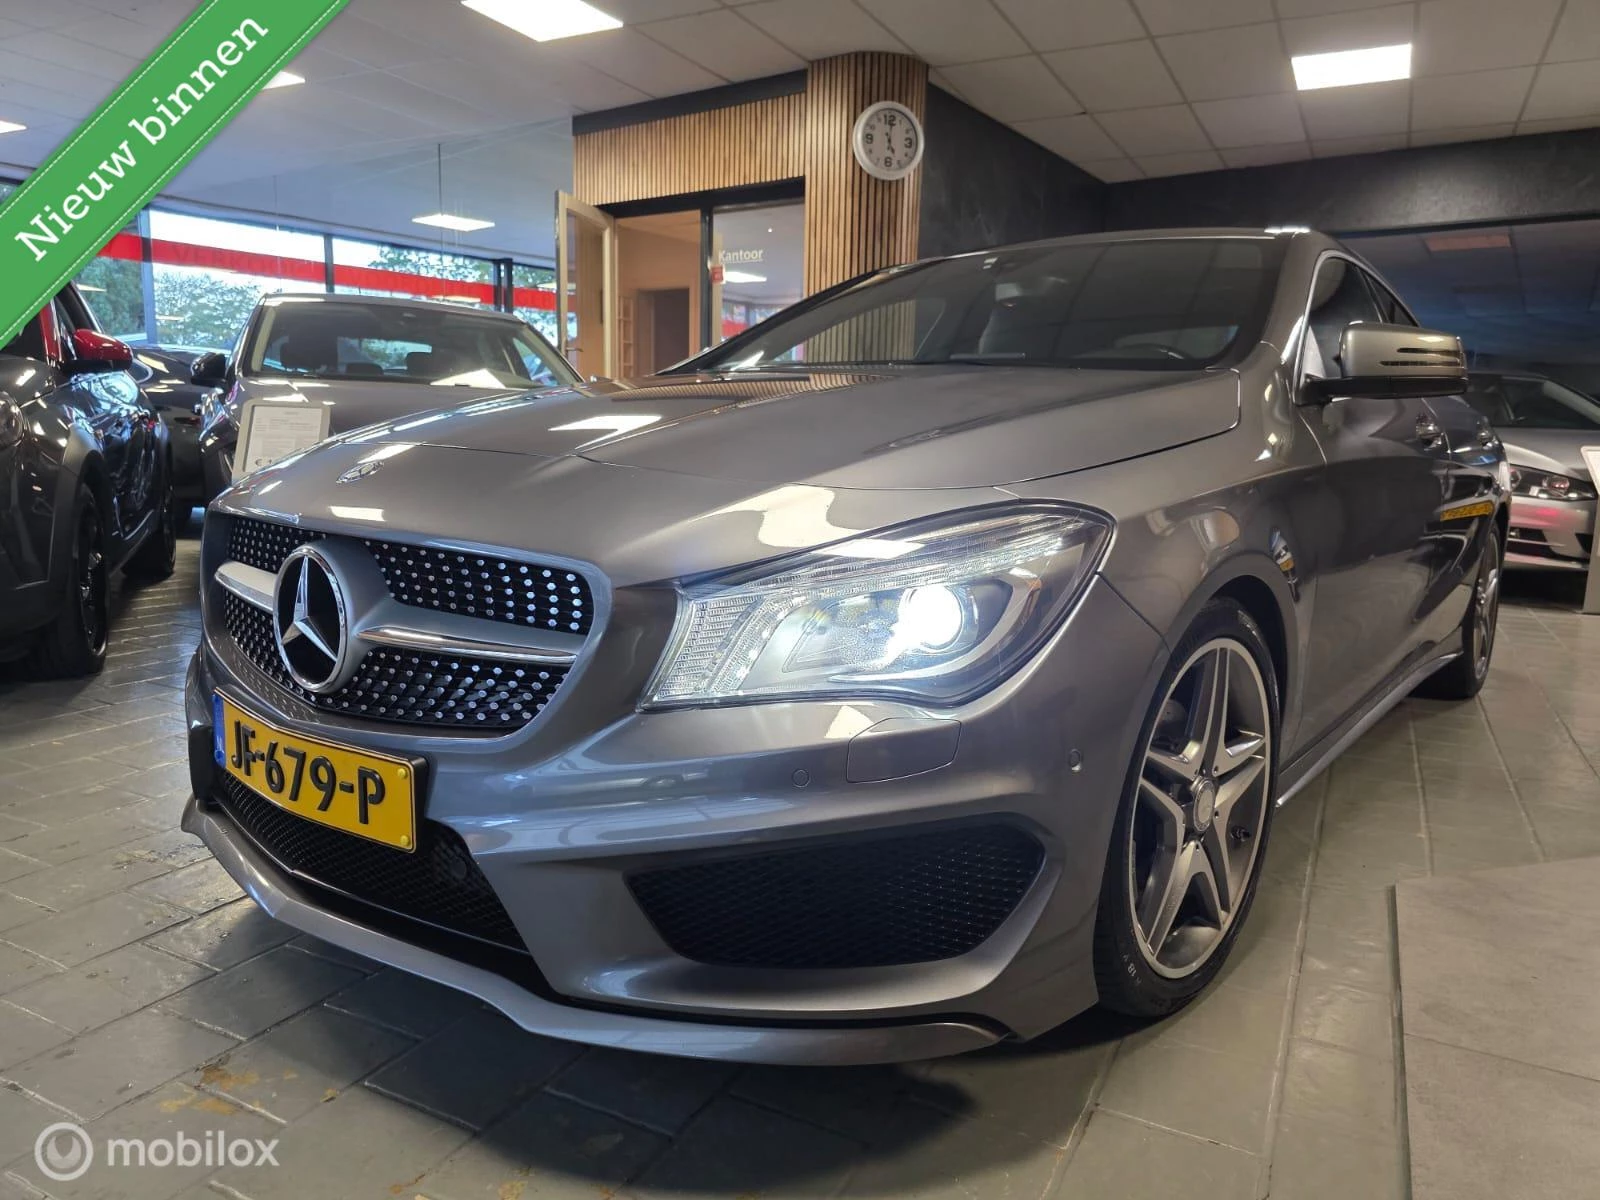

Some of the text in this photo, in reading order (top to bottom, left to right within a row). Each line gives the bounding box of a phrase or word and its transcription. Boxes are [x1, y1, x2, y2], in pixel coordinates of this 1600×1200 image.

[884, 113, 896, 126] 12
[904, 137, 913, 149] 3
[884, 156, 892, 168] 6
[718, 249, 763, 262] Kantoor
[231, 719, 386, 825] JF-679-P
